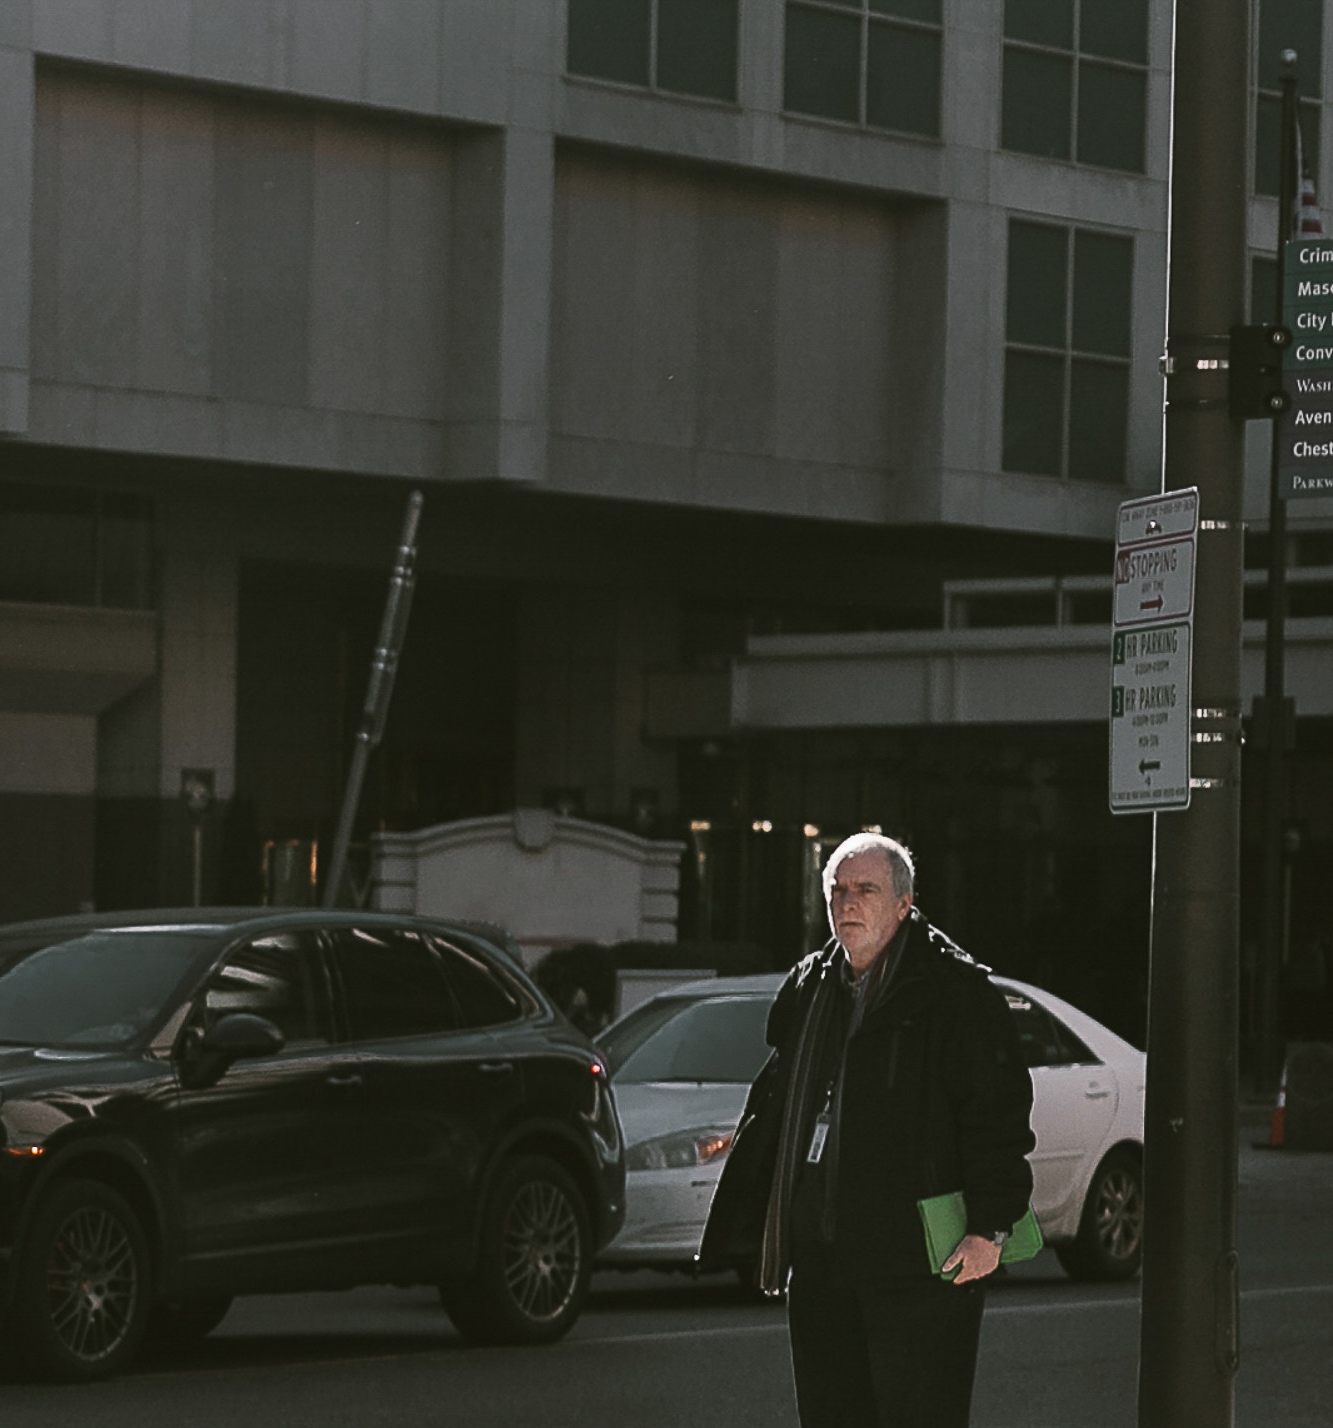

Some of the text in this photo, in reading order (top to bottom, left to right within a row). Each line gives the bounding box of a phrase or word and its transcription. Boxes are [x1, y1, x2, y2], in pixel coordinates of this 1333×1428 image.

[1300, 247, 1333, 264] Crim
[1297, 313, 1327, 332] City
[1296, 345, 1333, 361] Conv
[1294, 410, 1332, 425] Aven
[1129, 547, 1177, 579] STOPPING
[1141, 628, 1177, 656] PARKING
[1139, 683, 1176, 709] PARKING
